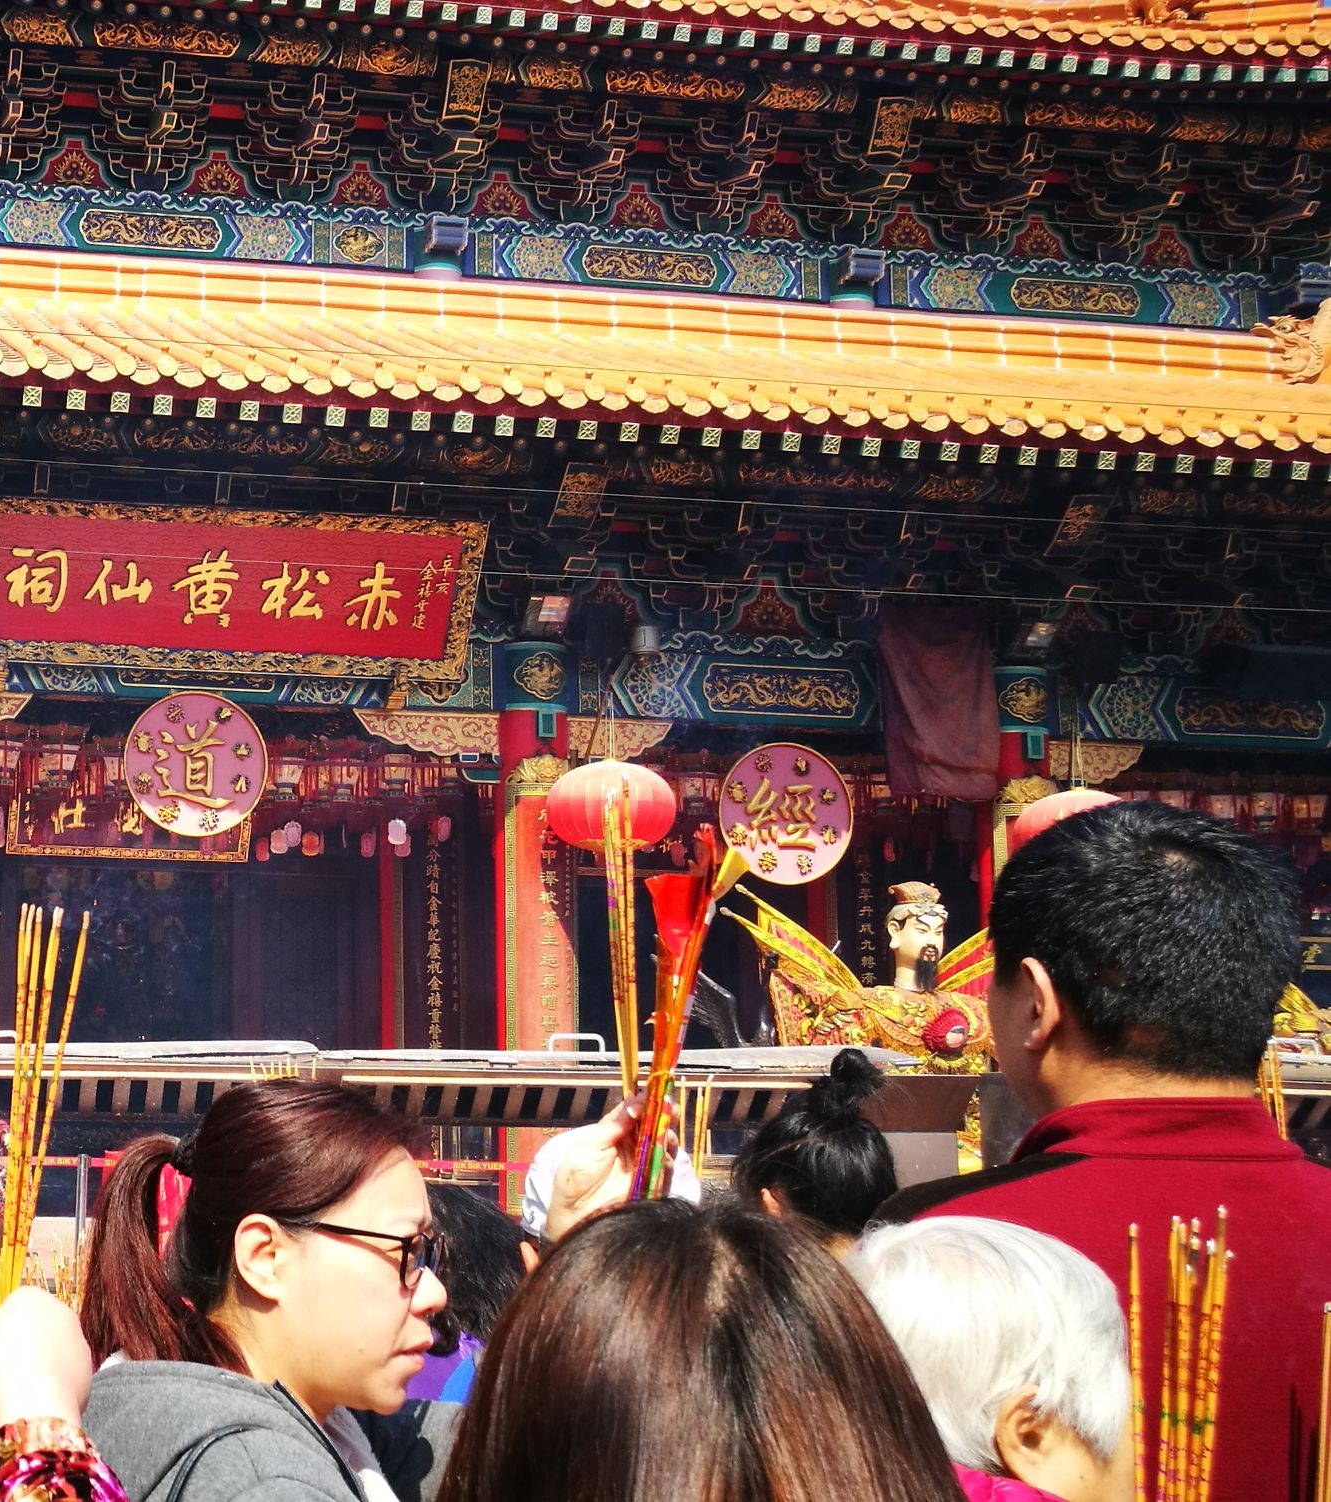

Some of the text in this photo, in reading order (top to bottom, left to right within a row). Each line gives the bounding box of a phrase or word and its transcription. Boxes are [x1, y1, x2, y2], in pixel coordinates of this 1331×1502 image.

[152, 718, 236, 808] 道
[745, 777, 817, 850] 經
[481, 1162, 505, 1170] YUEN
